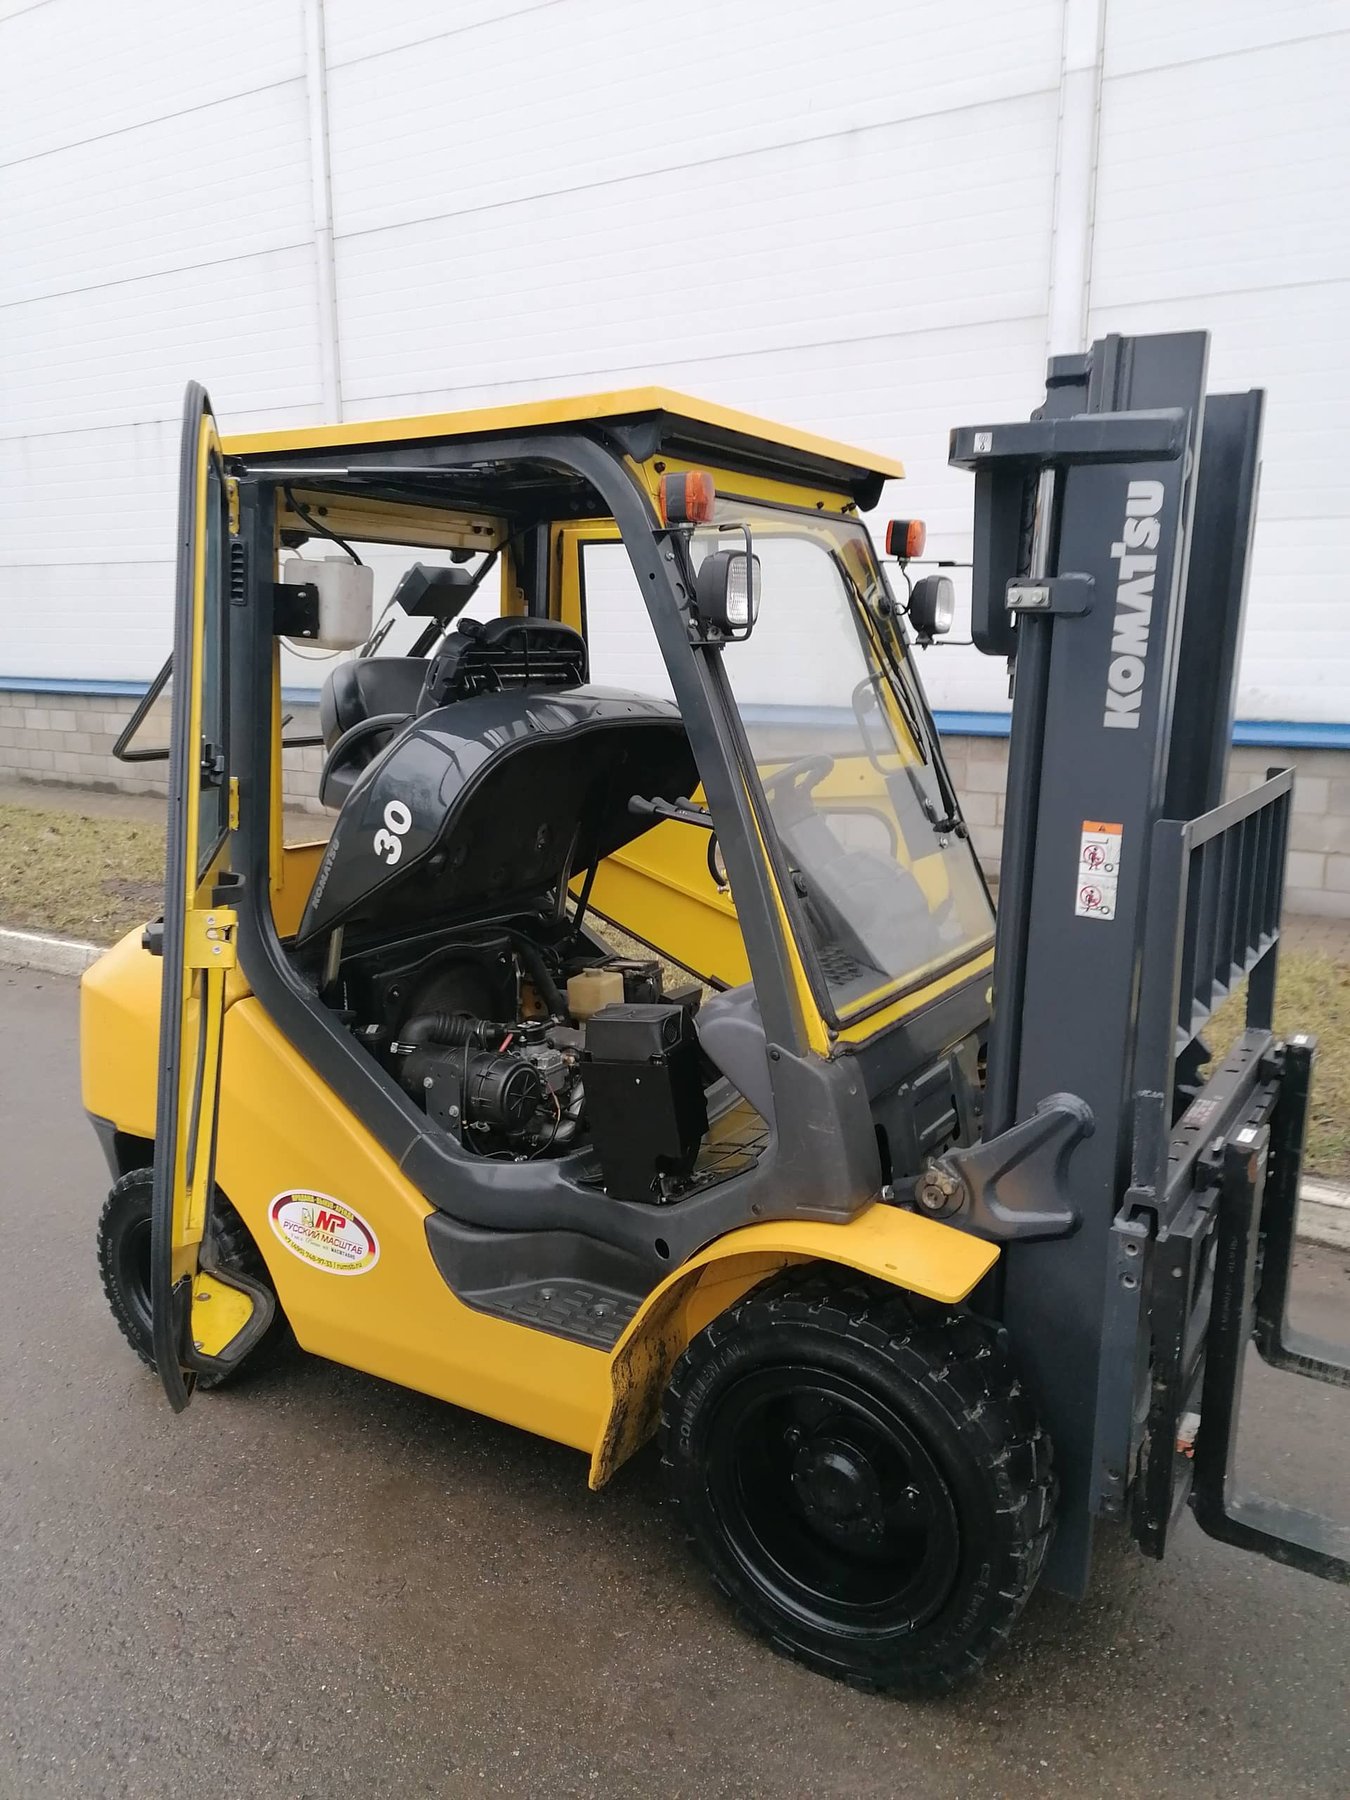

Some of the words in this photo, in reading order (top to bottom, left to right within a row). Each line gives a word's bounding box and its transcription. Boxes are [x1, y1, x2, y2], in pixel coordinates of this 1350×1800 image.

[1103, 480, 1165, 729] KOMATSU
[373, 799, 412, 865] 30
[283, 1221, 319, 1240] РУССКИЙ
[320, 1236, 363, 1255] МАСШТАБ
